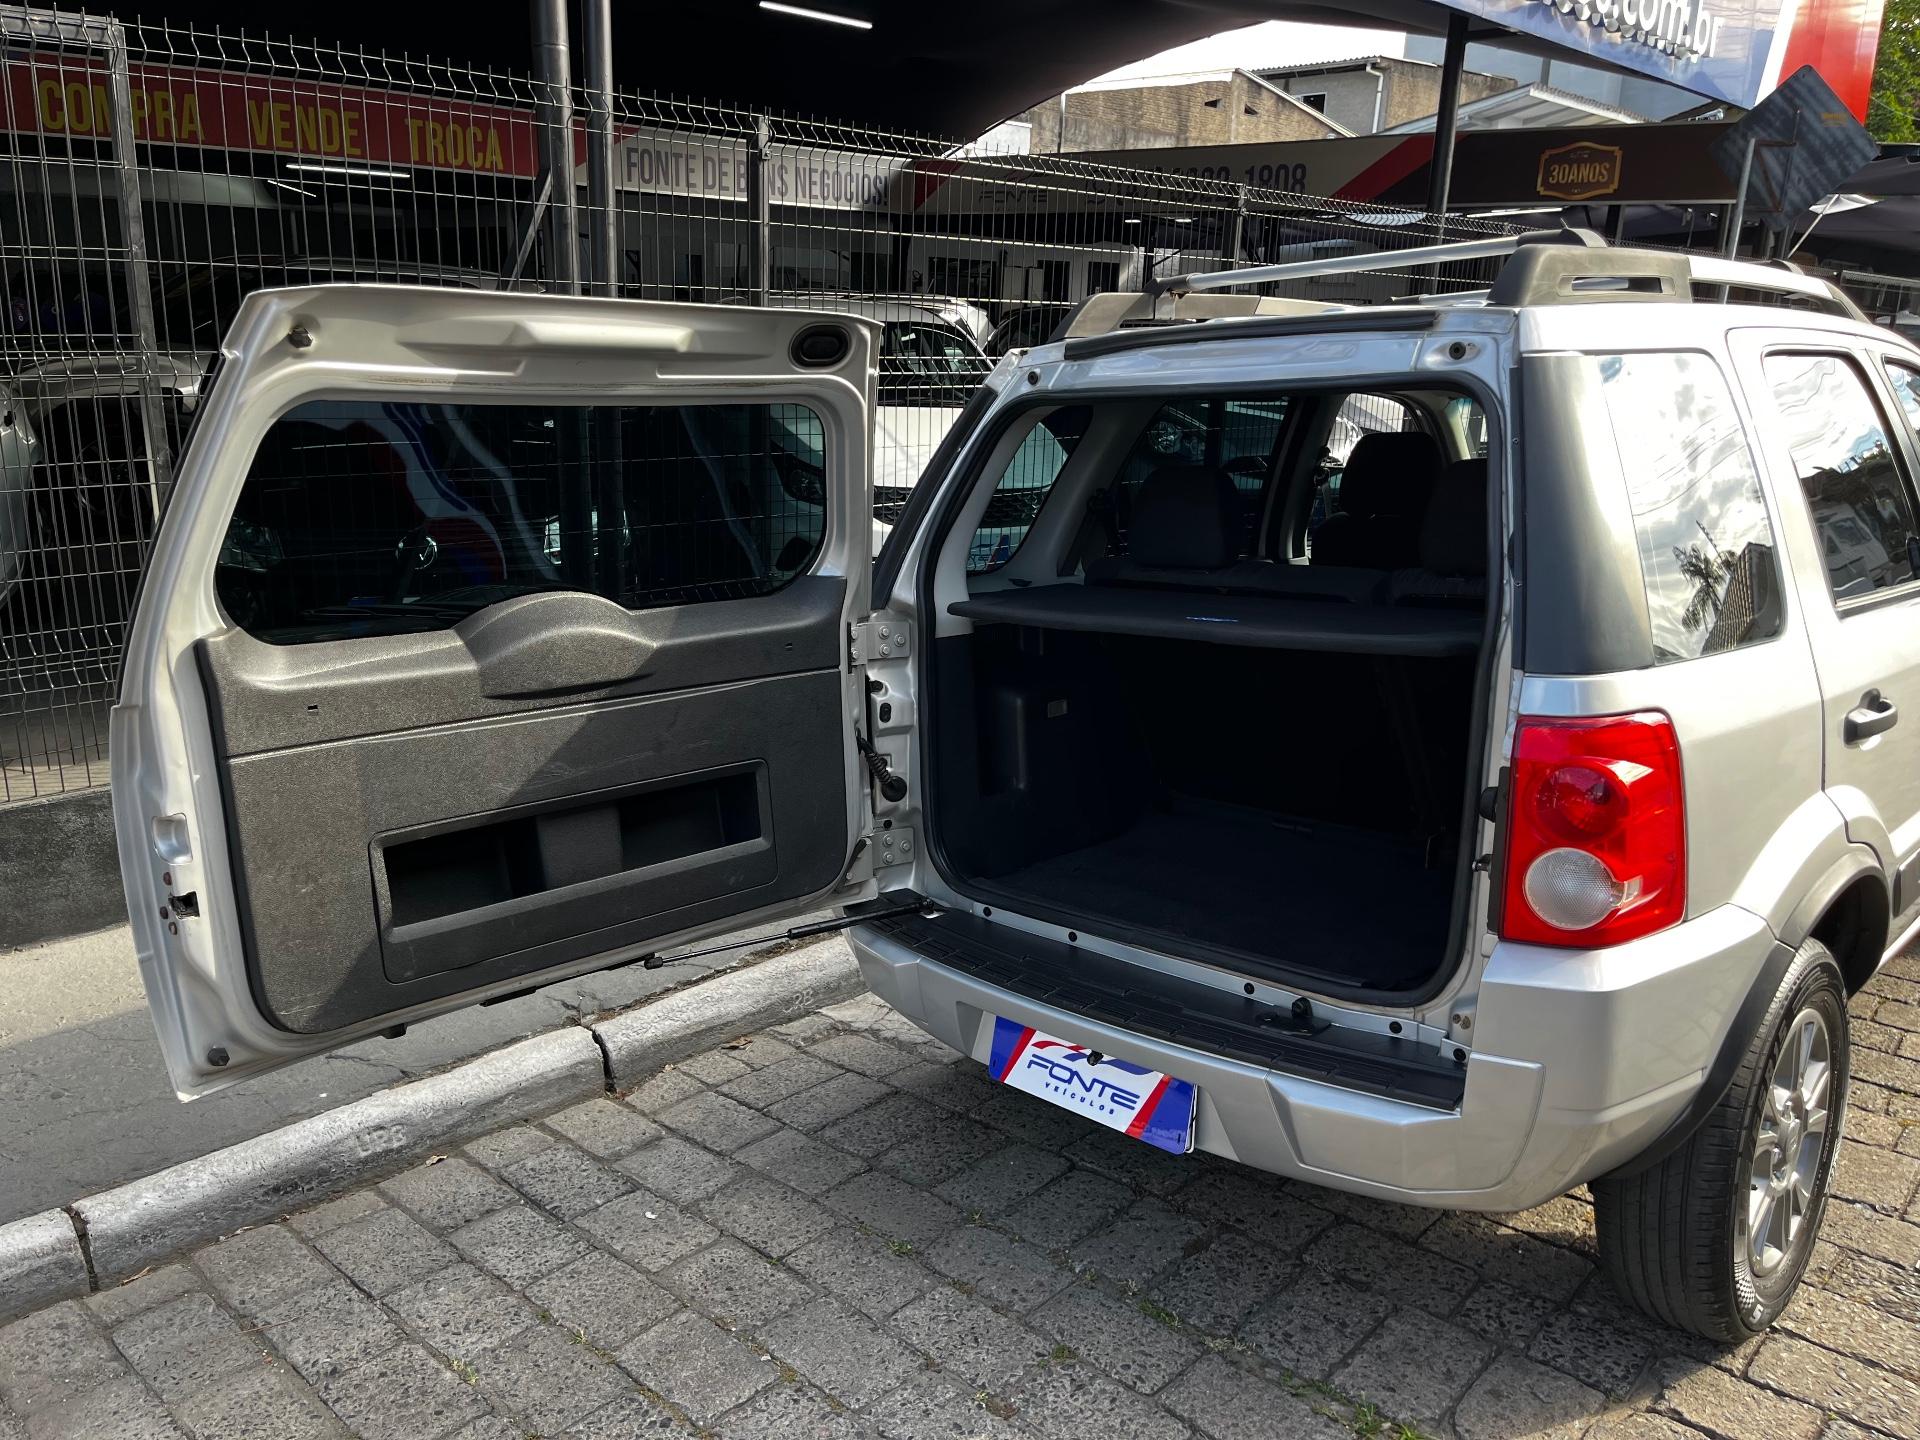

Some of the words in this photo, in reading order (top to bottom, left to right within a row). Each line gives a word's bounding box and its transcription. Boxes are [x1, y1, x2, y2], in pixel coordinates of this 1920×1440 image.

[251, 99, 362, 156] VENDE
[404, 117, 505, 171] TROCA
[626, 146, 697, 189] FONTE
[703, 155, 730, 192] DE
[735, 159, 789, 198] BNS
[1027, 1053, 1141, 1111] FONTE
